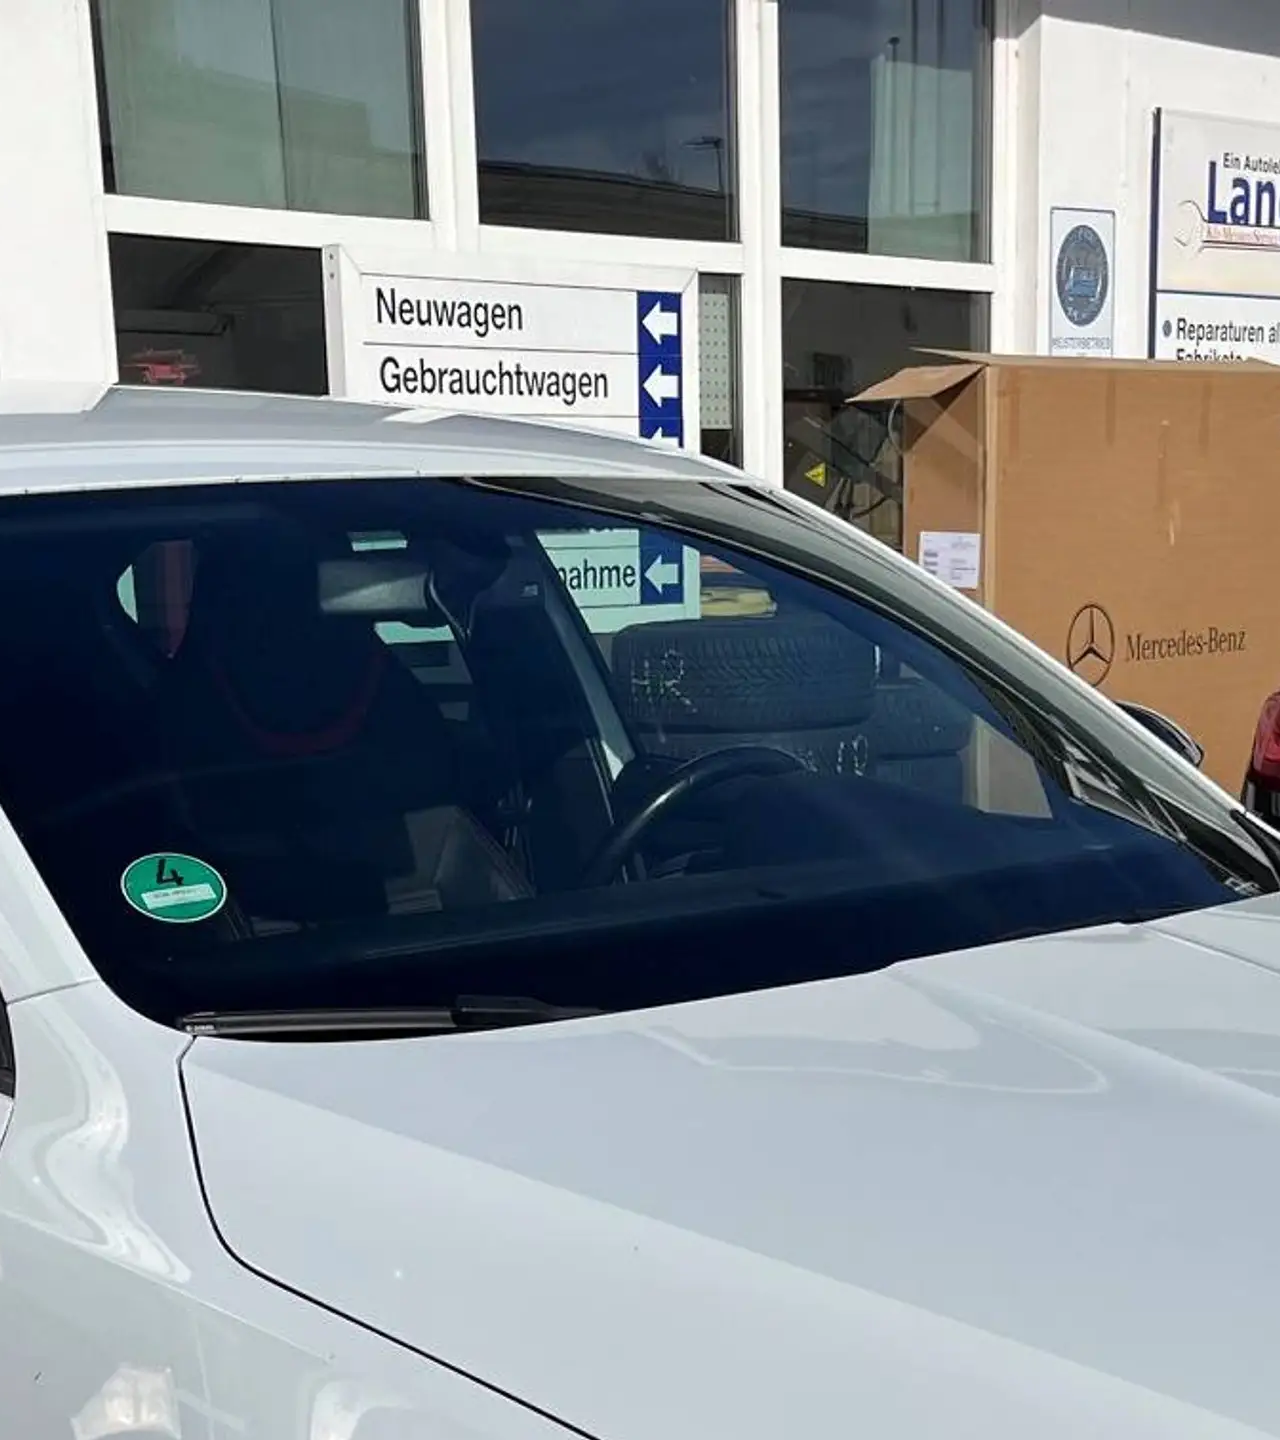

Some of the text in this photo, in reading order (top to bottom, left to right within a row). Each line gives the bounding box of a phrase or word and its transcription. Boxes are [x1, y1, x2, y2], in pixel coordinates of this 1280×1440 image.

[1223, 152, 1241, 169] Ein
[375, 287, 524, 338] Neuwagen
[1176, 317, 1265, 347] Reparaturen
[378, 356, 609, 406] Gebrauchtwagen
[1125, 627, 1247, 662] Mercedes-Benz
[156, 858, 184, 886] 4
